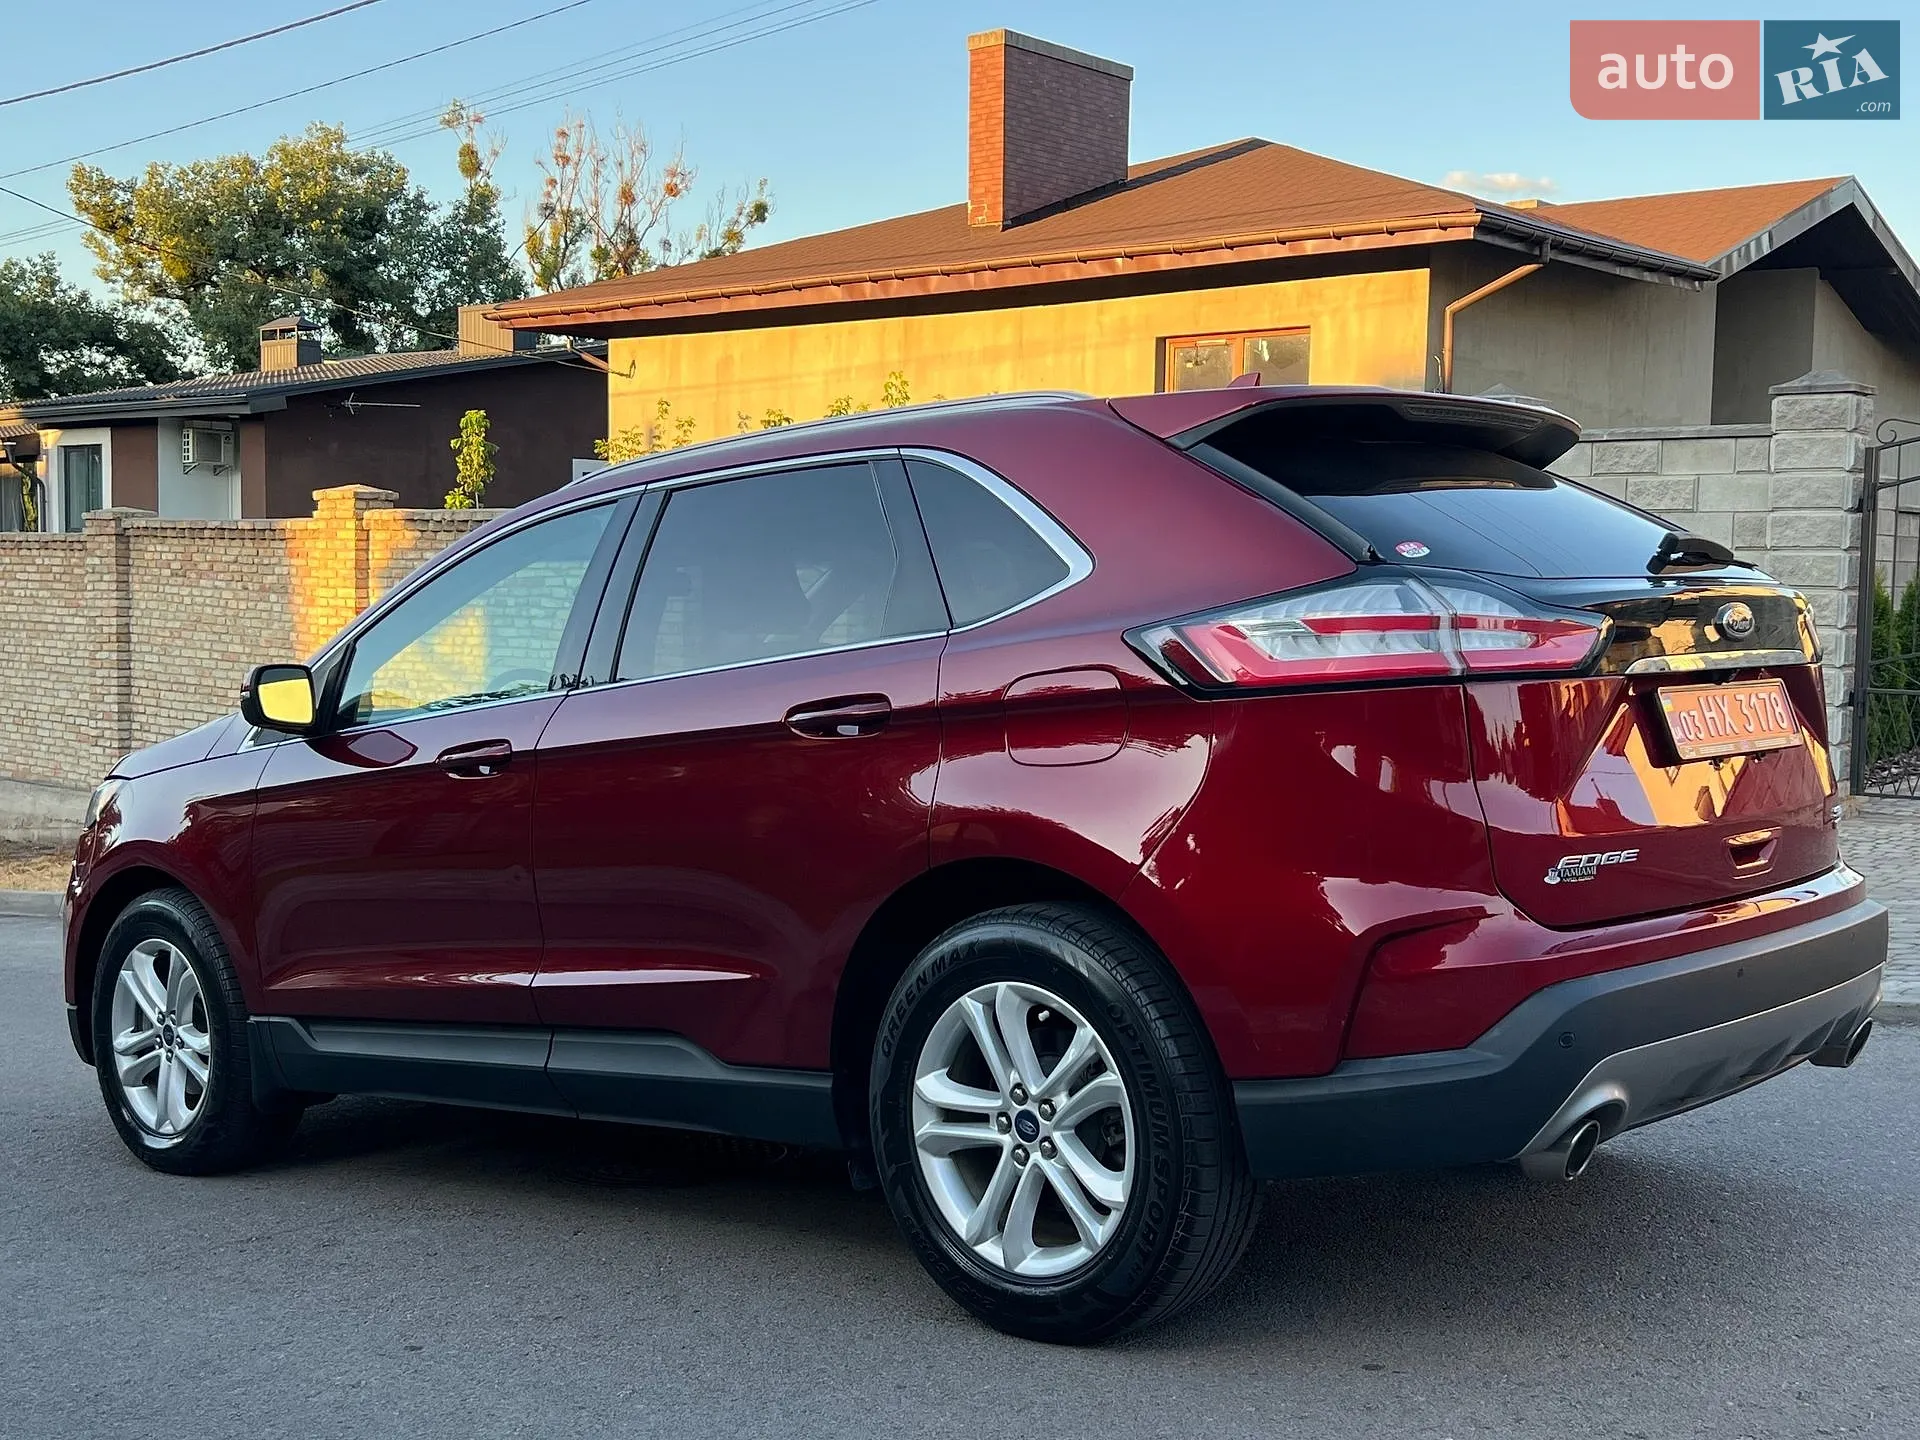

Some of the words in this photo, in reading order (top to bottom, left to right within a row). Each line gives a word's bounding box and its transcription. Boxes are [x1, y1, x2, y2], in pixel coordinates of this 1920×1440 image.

[1698, 694, 1740, 737] HX
[1734, 691, 1788, 733] 3178
[1557, 848, 1640, 870] EDGE
